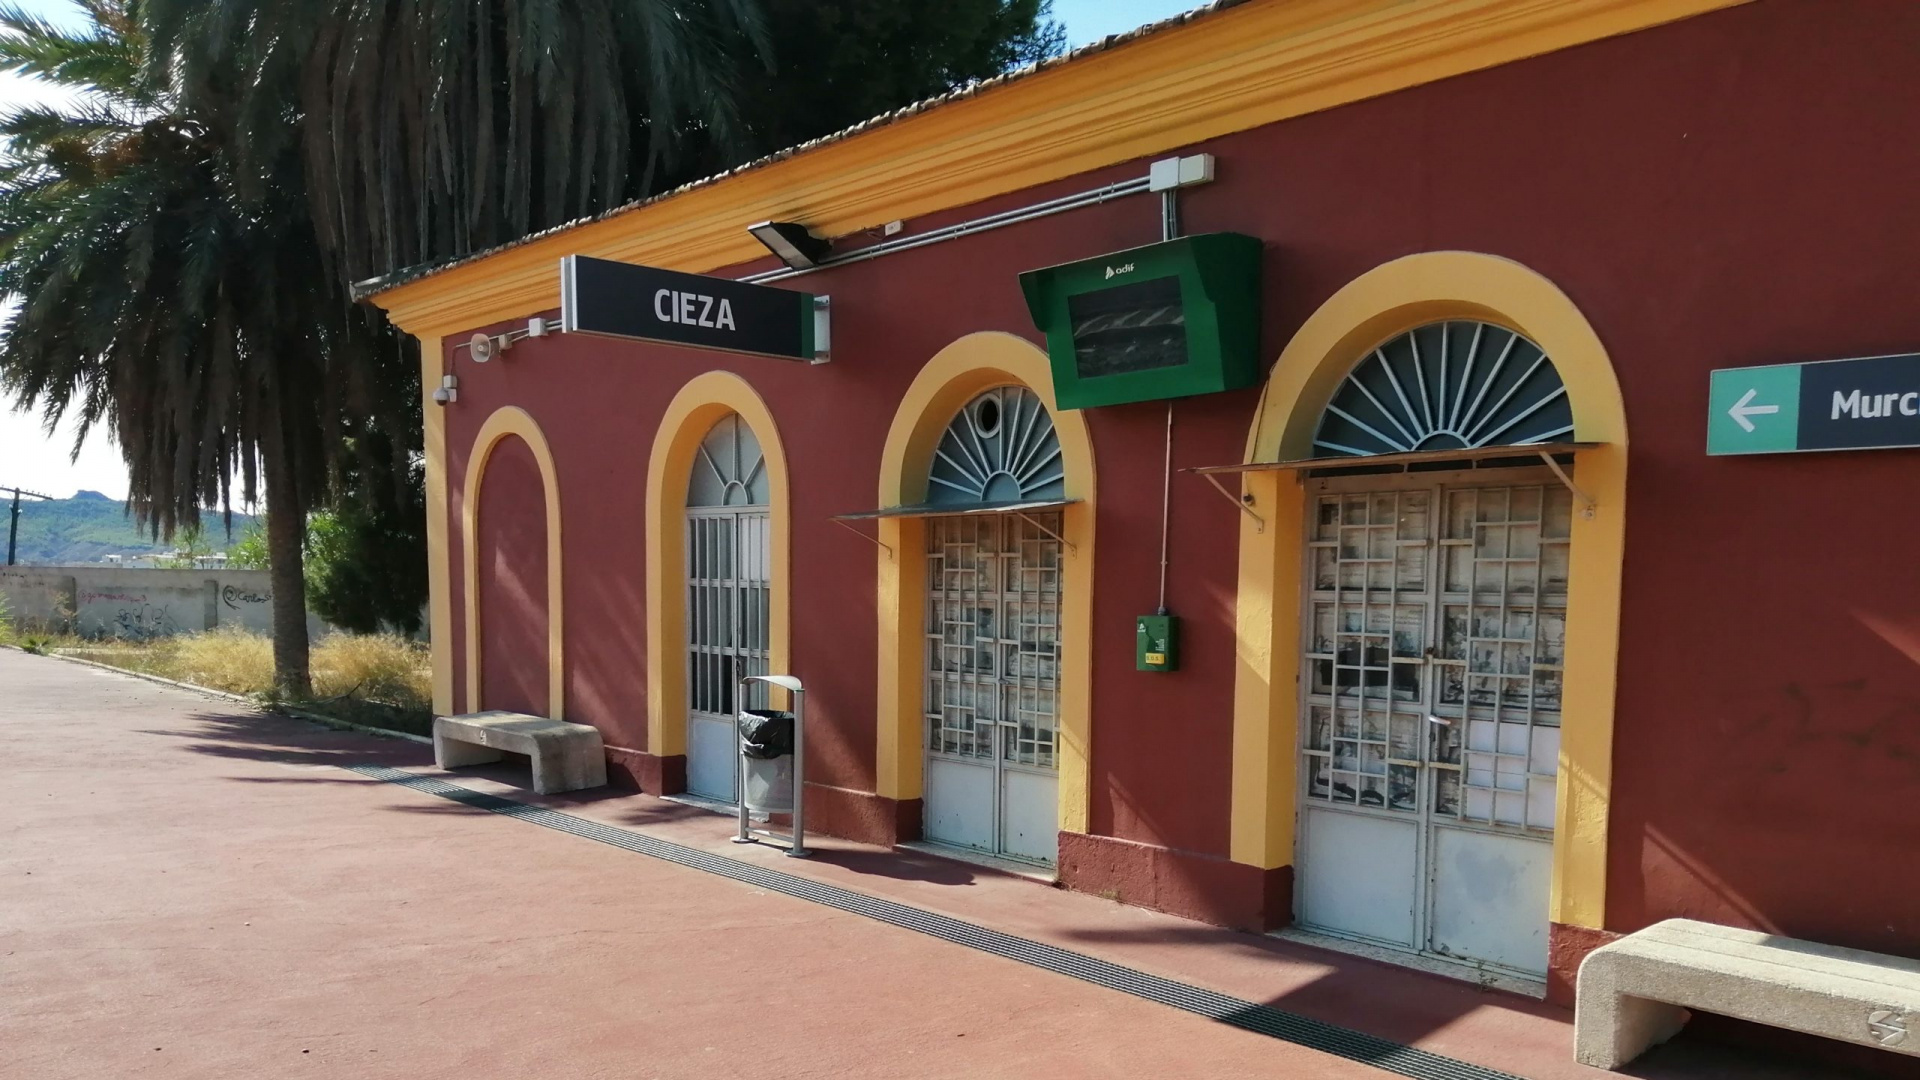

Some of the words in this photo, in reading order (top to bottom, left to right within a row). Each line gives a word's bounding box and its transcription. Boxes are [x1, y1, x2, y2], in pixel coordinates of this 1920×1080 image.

[1115, 262, 1135, 274] adif
[654, 288, 736, 331] CIEZA
[1831, 389, 1920, 420] Murc
